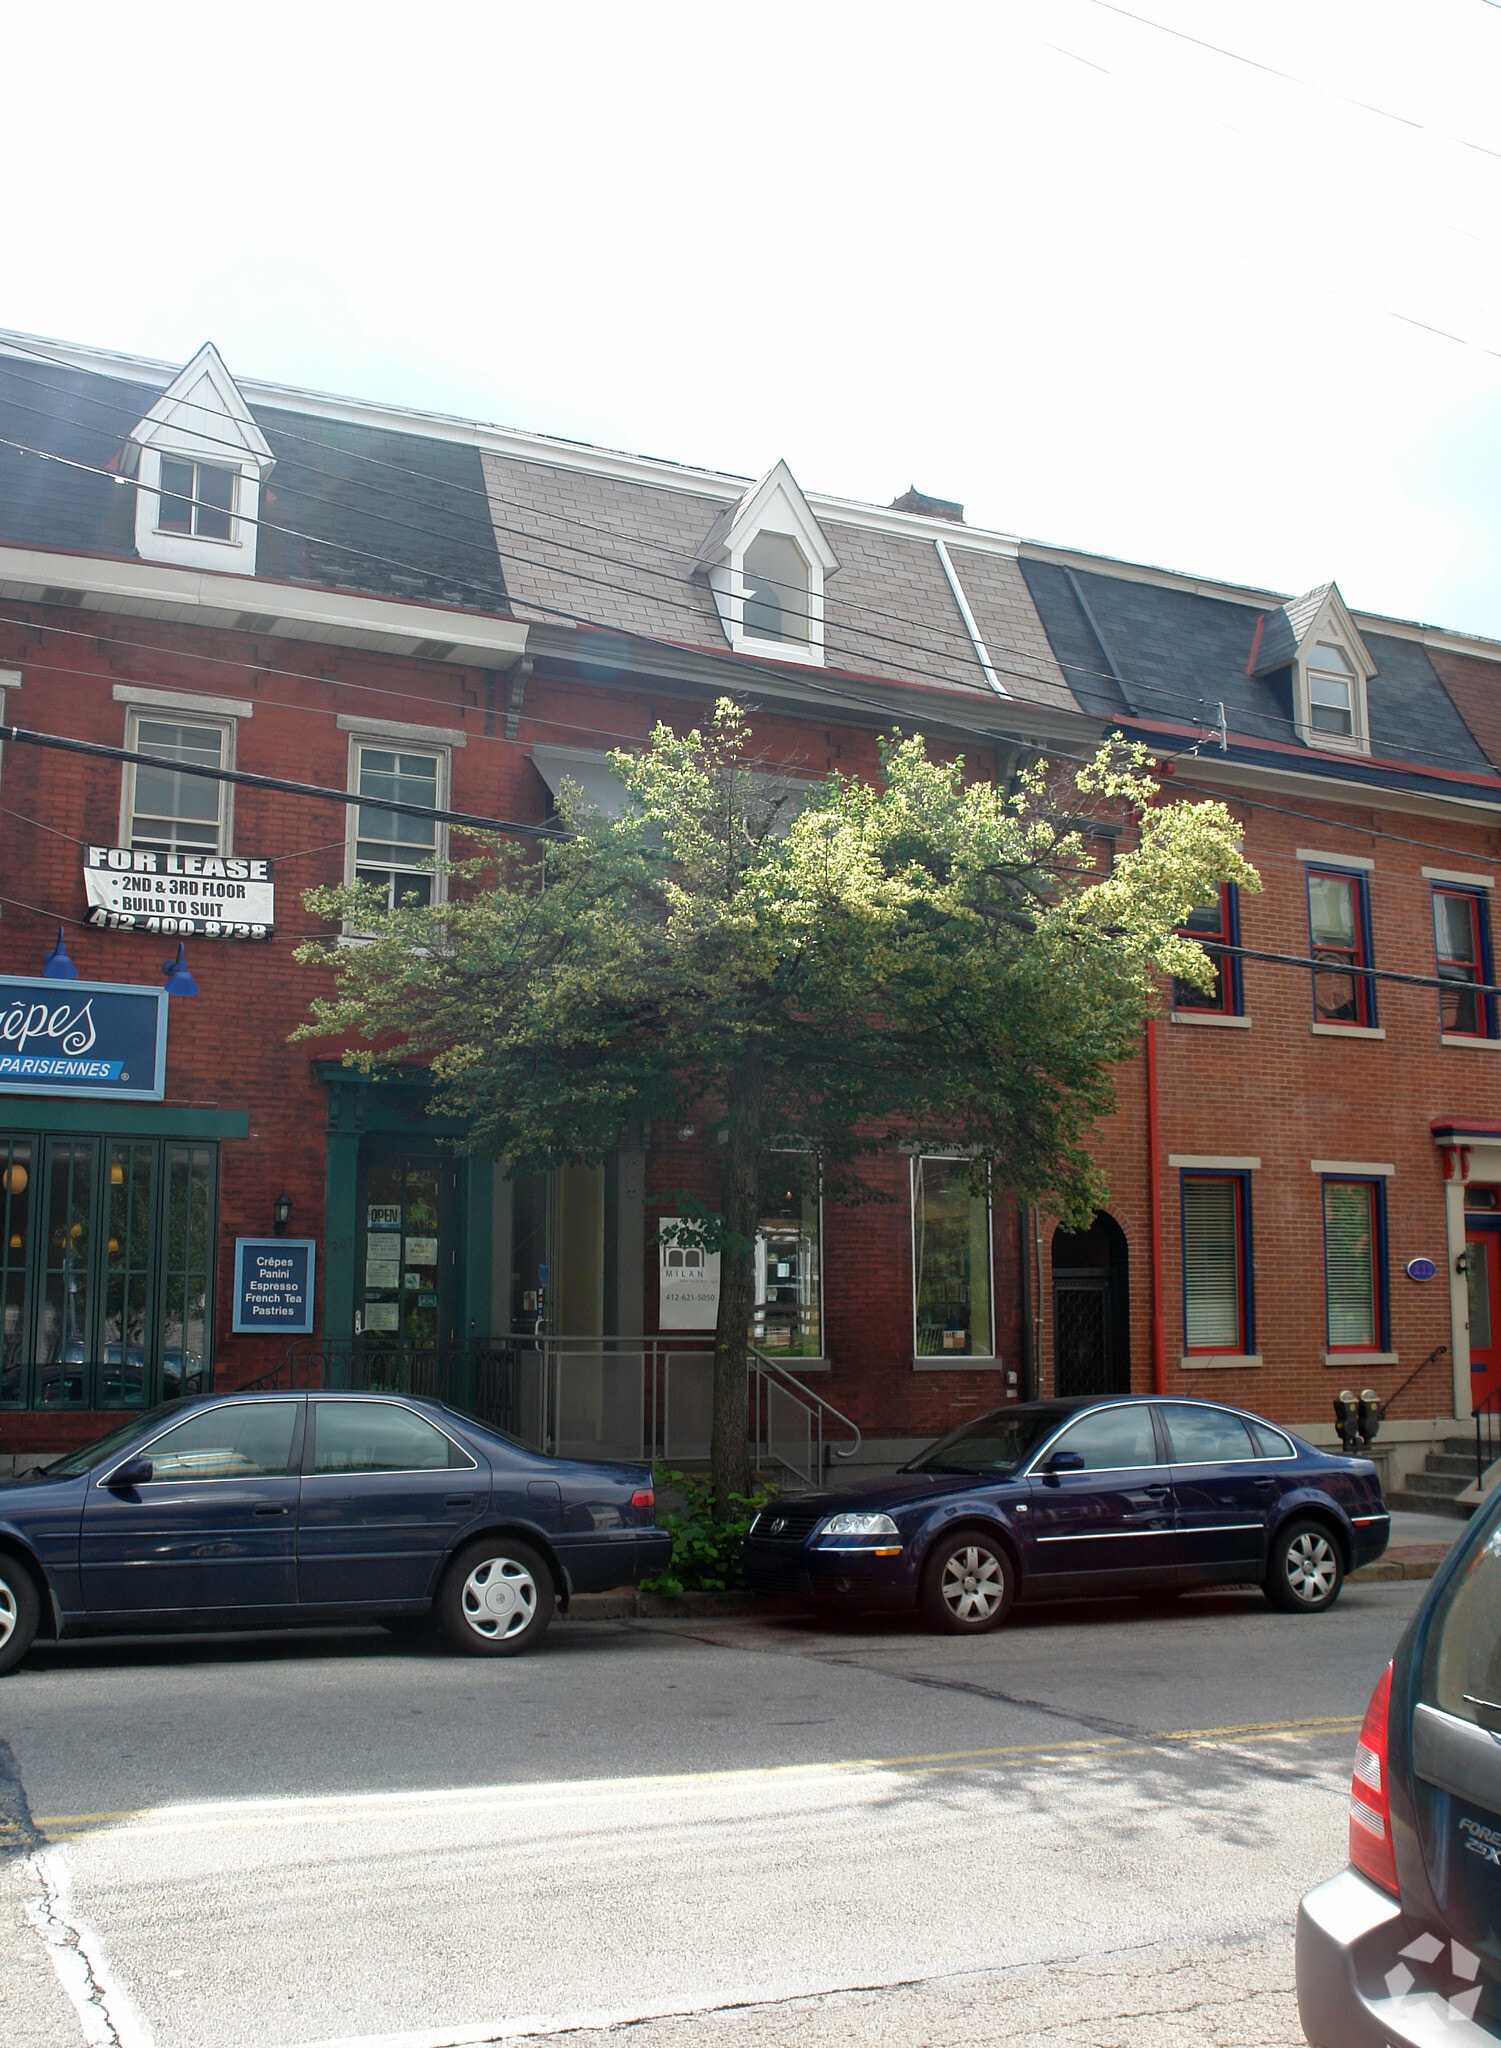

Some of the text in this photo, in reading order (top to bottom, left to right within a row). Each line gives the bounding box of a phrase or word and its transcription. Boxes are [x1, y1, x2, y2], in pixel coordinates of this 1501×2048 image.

[89, 846, 268, 880] FOR LEASE
[122, 876, 246, 899] 2ND & 3RD FLOOR
[122, 896, 224, 918] BUILD TO SUIT
[89, 908, 267, 939] 412-400-8738
[0, 998, 97, 1056] êpes
[0, 1057, 111, 1077] PARISIENNES
[371, 1208, 398, 1223] OPEN
[259, 1268, 290, 1279] Panini
[665, 1270, 704, 1278] MILAN
[250, 1280, 299, 1292] Espresso
[245, 1292, 302, 1303] French Tea
[665, 1293, 715, 1301] 412-621-5050
[252, 1305, 295, 1316] Pastries
